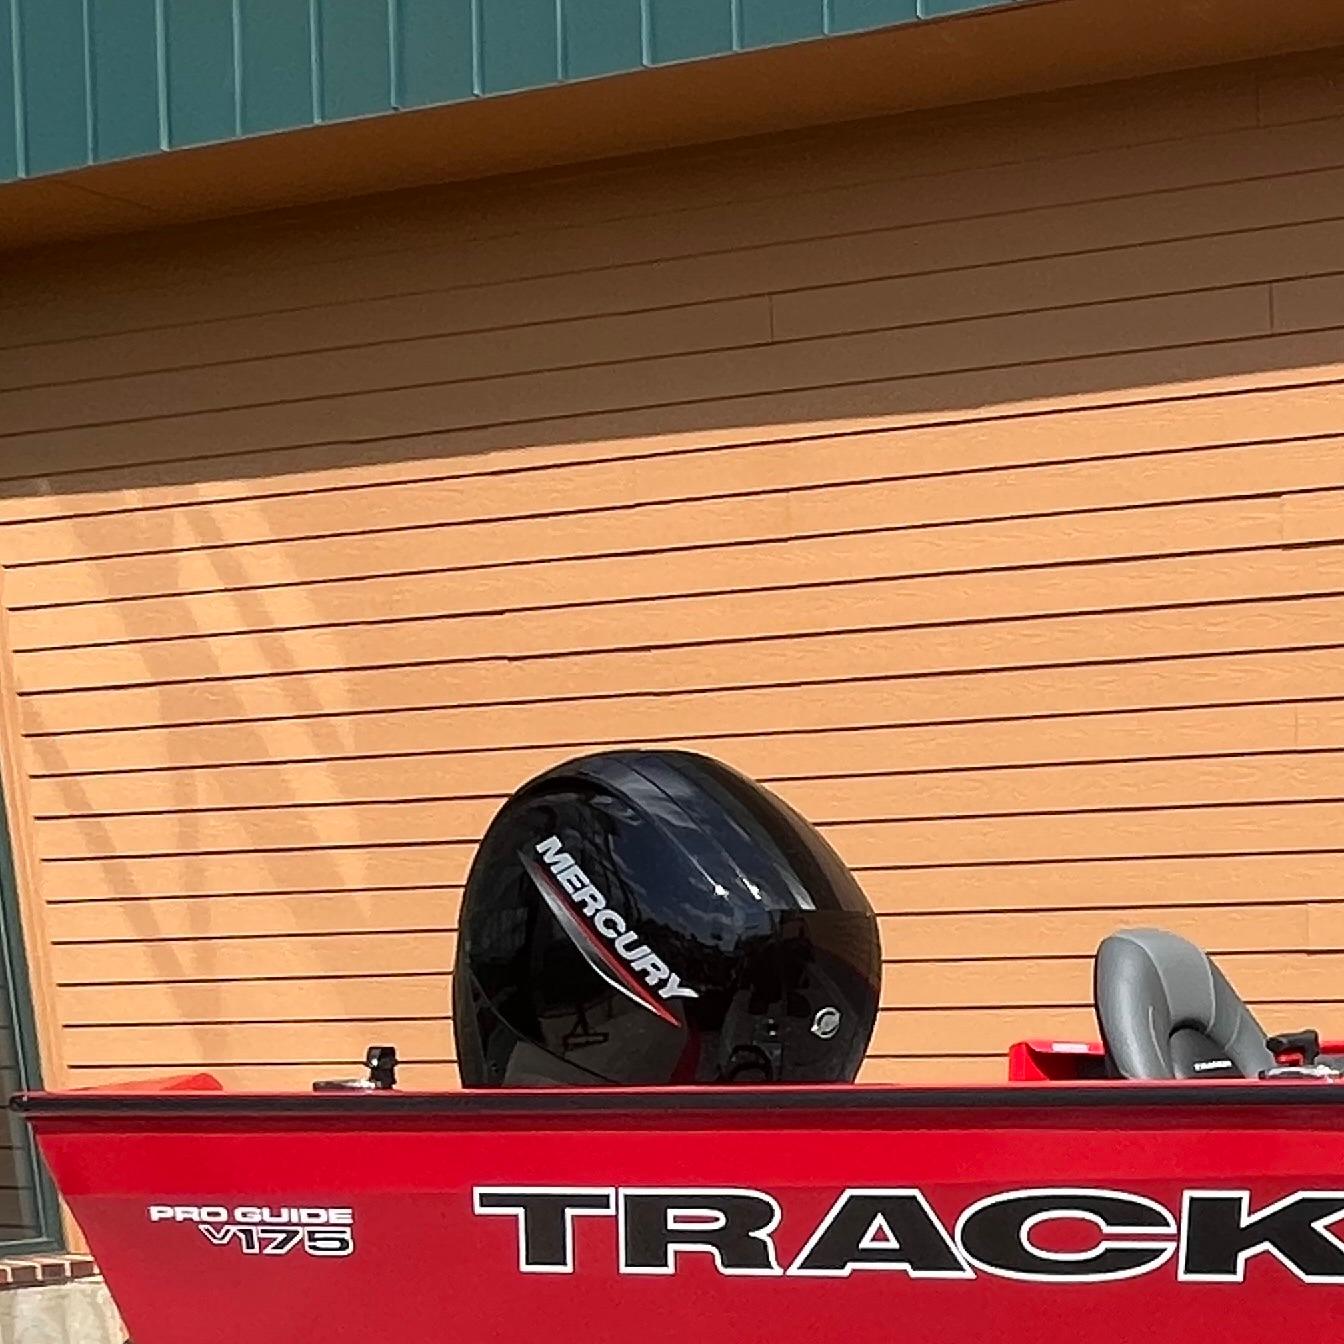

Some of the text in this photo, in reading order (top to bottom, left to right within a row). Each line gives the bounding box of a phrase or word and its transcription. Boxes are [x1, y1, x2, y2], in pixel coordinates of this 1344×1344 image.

[536, 835, 699, 998] MERCURY
[148, 1206, 354, 1224] PRO GUIDE
[198, 1225, 354, 1256] V175
